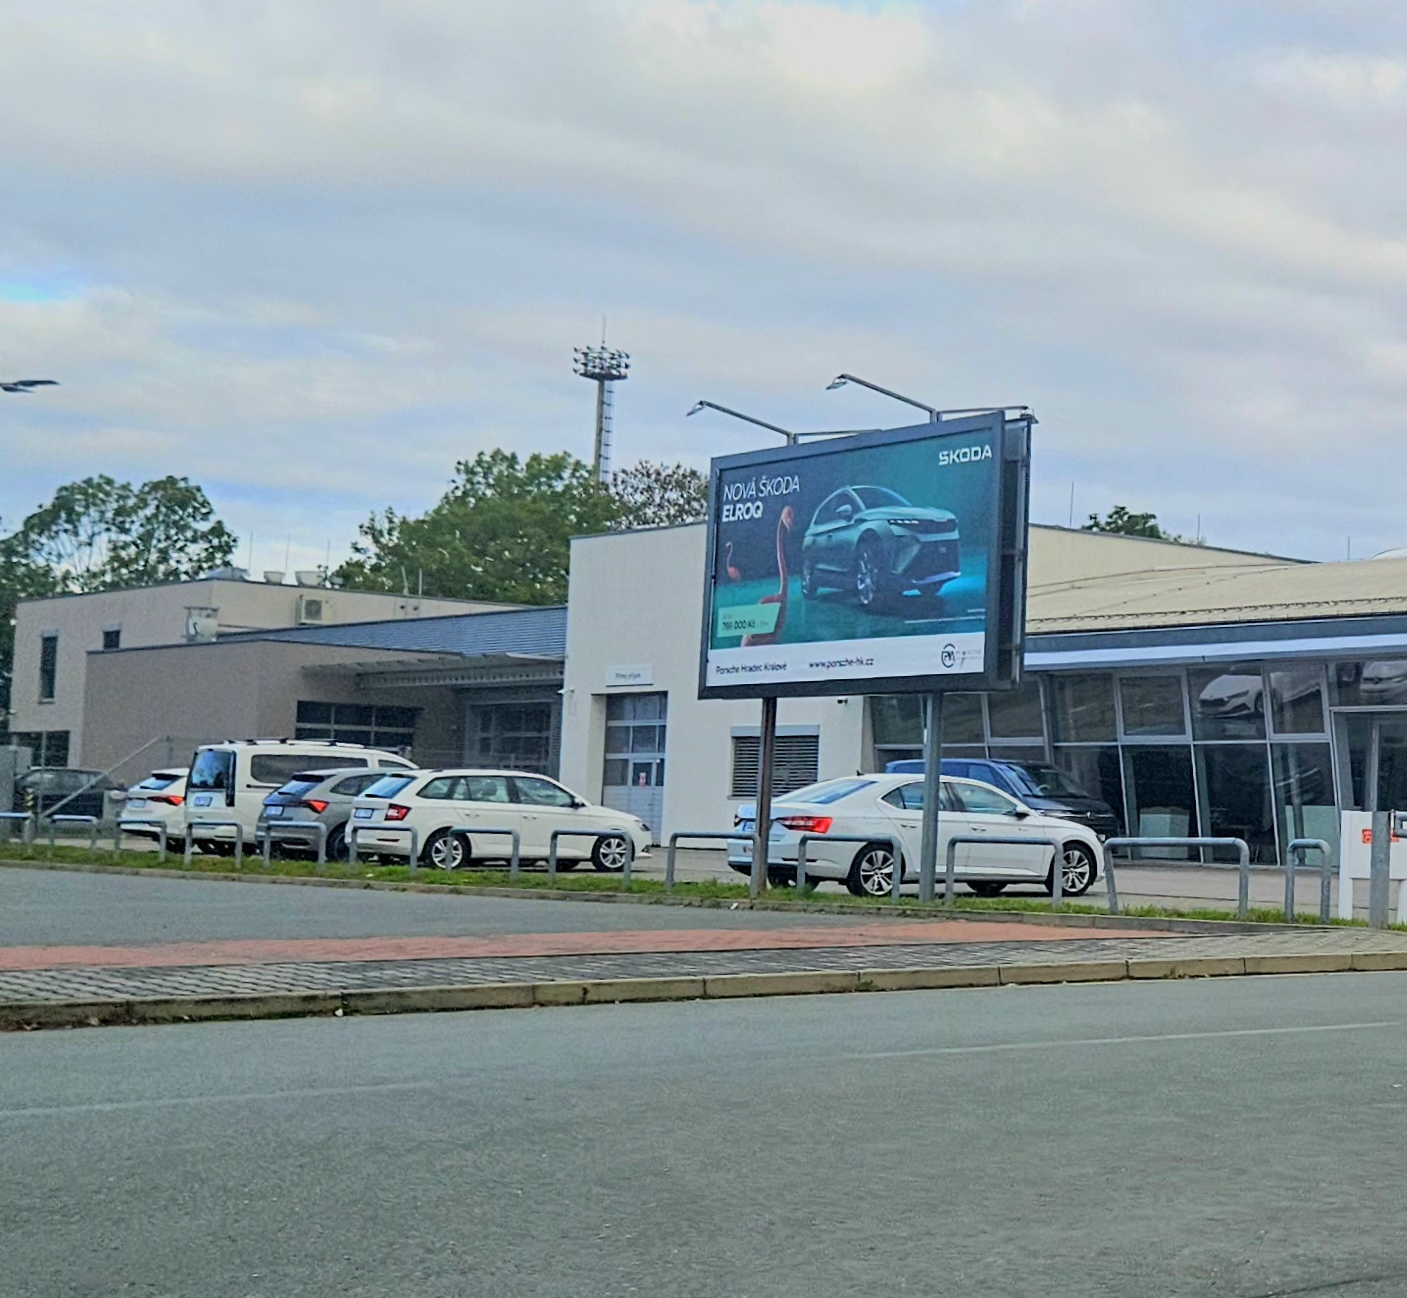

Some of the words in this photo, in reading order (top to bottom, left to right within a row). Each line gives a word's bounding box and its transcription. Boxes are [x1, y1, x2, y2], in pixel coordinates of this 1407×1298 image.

[722, 476, 757, 502] NOVÁ
[758, 474, 800, 498] ŠKODA
[721, 500, 764, 523] ELROQ
